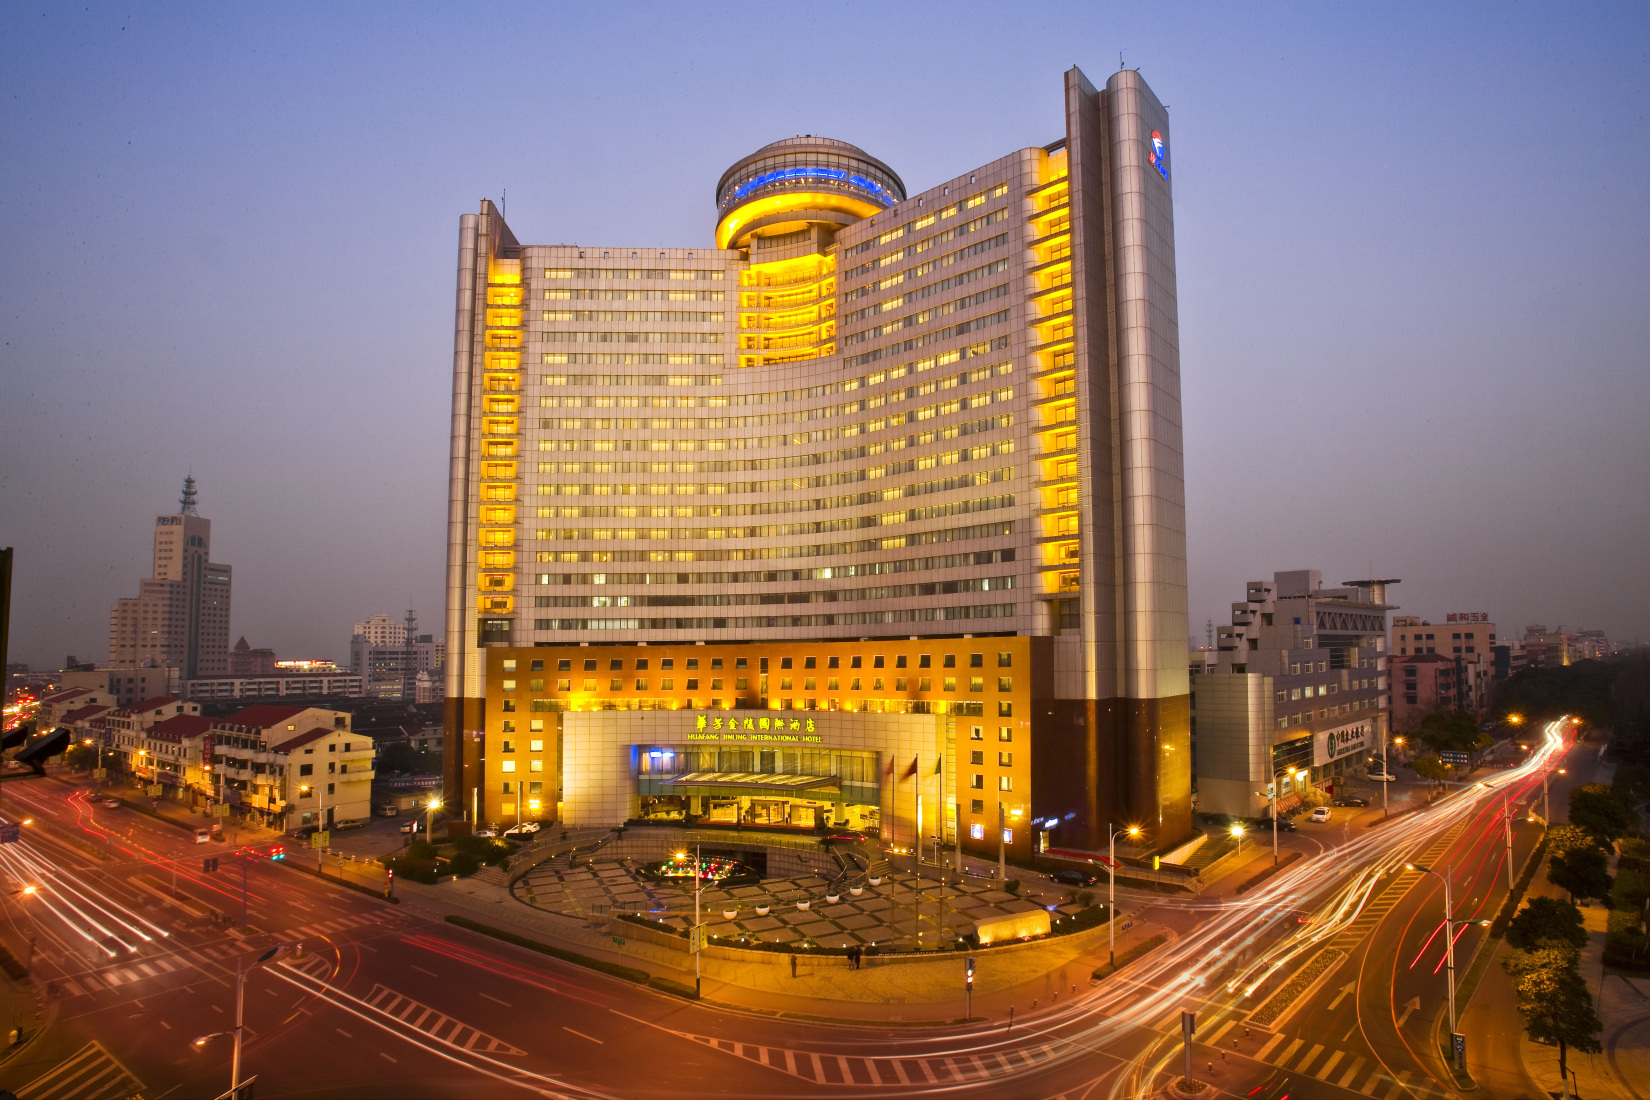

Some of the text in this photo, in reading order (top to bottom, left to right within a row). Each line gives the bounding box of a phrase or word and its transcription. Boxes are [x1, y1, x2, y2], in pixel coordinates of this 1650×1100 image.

[696, 714, 815, 732] 華芳金陵國際酒店
[687, 733, 719, 741] HUAFANG
[750, 734, 799, 742] INTERNATIONAL
[803, 735, 822, 743] HOTEL
